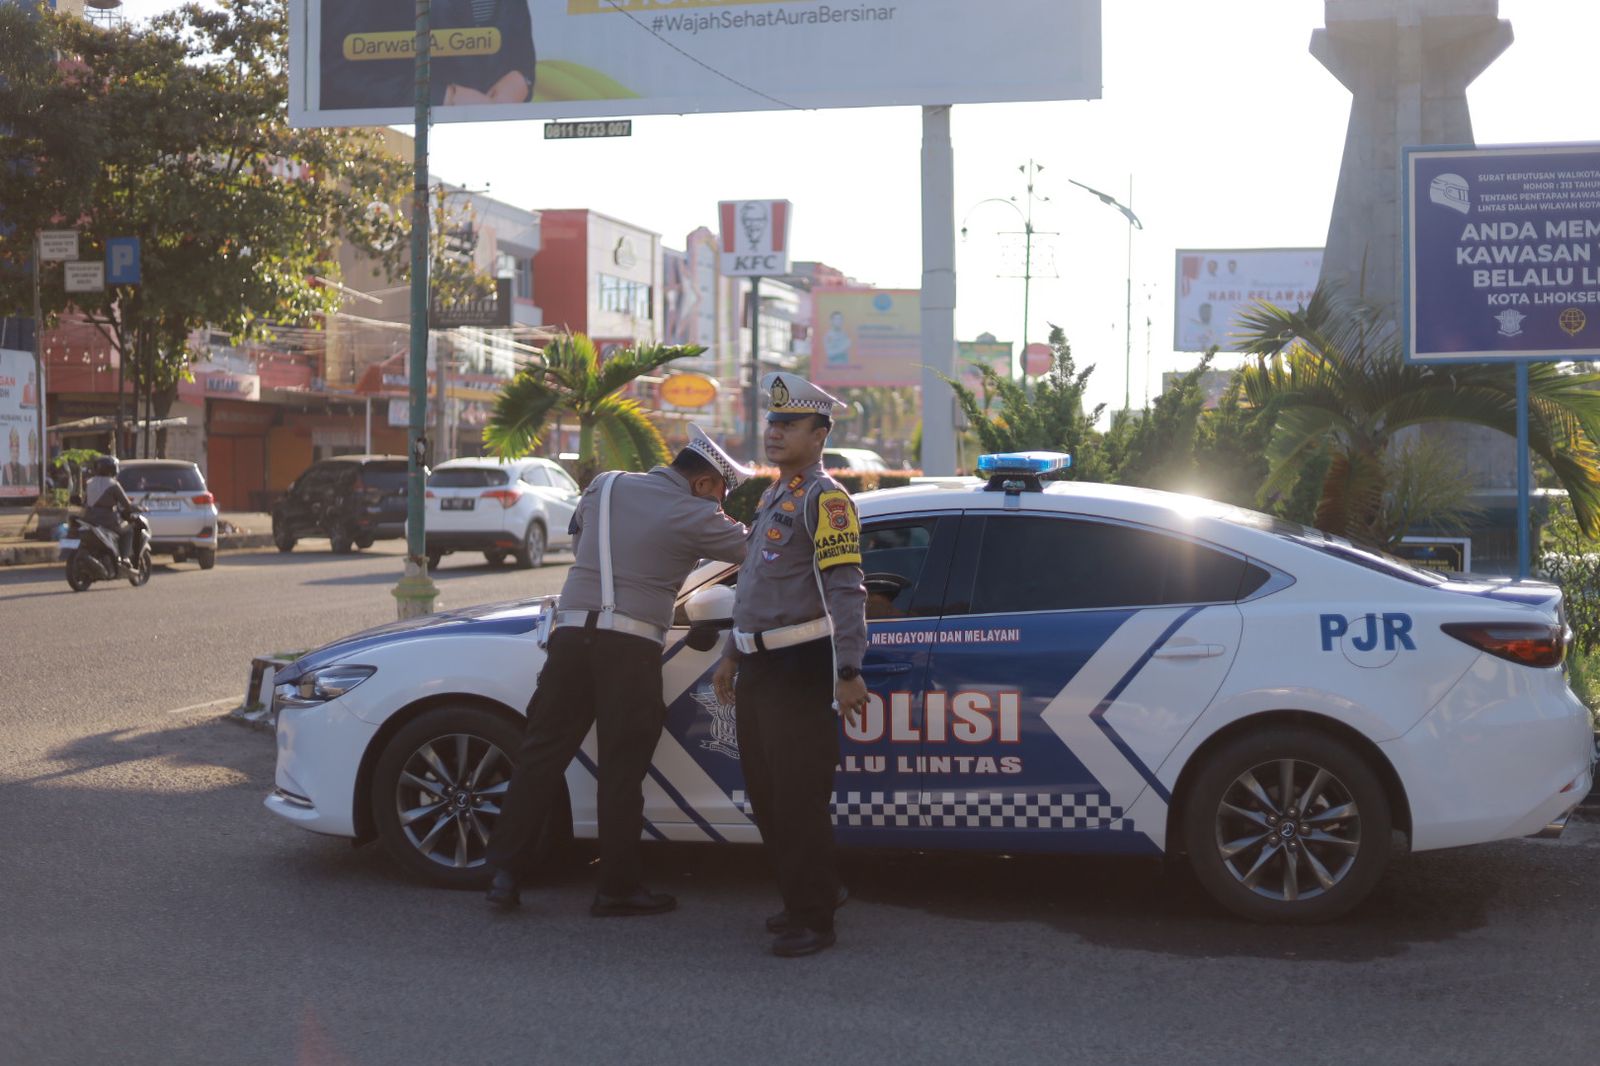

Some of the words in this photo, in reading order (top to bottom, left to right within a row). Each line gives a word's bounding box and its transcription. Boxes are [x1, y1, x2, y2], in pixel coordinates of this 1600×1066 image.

[652, 4, 897, 35] #WajahSehatAuraBersinar
[449, 31, 492, 50] Gani
[545, 124, 574, 138] 0811
[577, 123, 605, 137] 6733
[607, 122, 630, 136] 007
[1478, 173, 1506, 182] SURAT
[1506, 171, 1556, 181] KEPUTUSAN
[1557, 170, 1600, 179] WALIKOTA
[1523, 182, 1555, 190] NOMOR
[1480, 193, 1518, 202] TENTANG
[1520, 191, 1569, 201] PENETAPAN
[1478, 203, 1506, 212] LINTAS
[1508, 202, 1538, 211] DALAM
[1540, 201, 1578, 210] WILAYAH
[1461, 222, 1538, 241] ANDA
[1545, 219, 1600, 239] MEM
[112, 245, 134, 276] P
[1456, 243, 1591, 265] KAWASAN
[733, 255, 778, 270] KFC
[1473, 267, 1574, 288] BELALU
[1208, 290, 1242, 301] HARI
[1487, 293, 1530, 305] KOTA
[771, 511, 794, 527] POLRI
[871, 631, 938, 645] MENGAYOMI
[939, 631, 962, 643] DAN
[964, 629, 1020, 642] MELAYANI
[1319, 612, 1417, 652] PJR
[844, 690, 1021, 744] OLISI
[897, 756, 1023, 774] LINTAS
